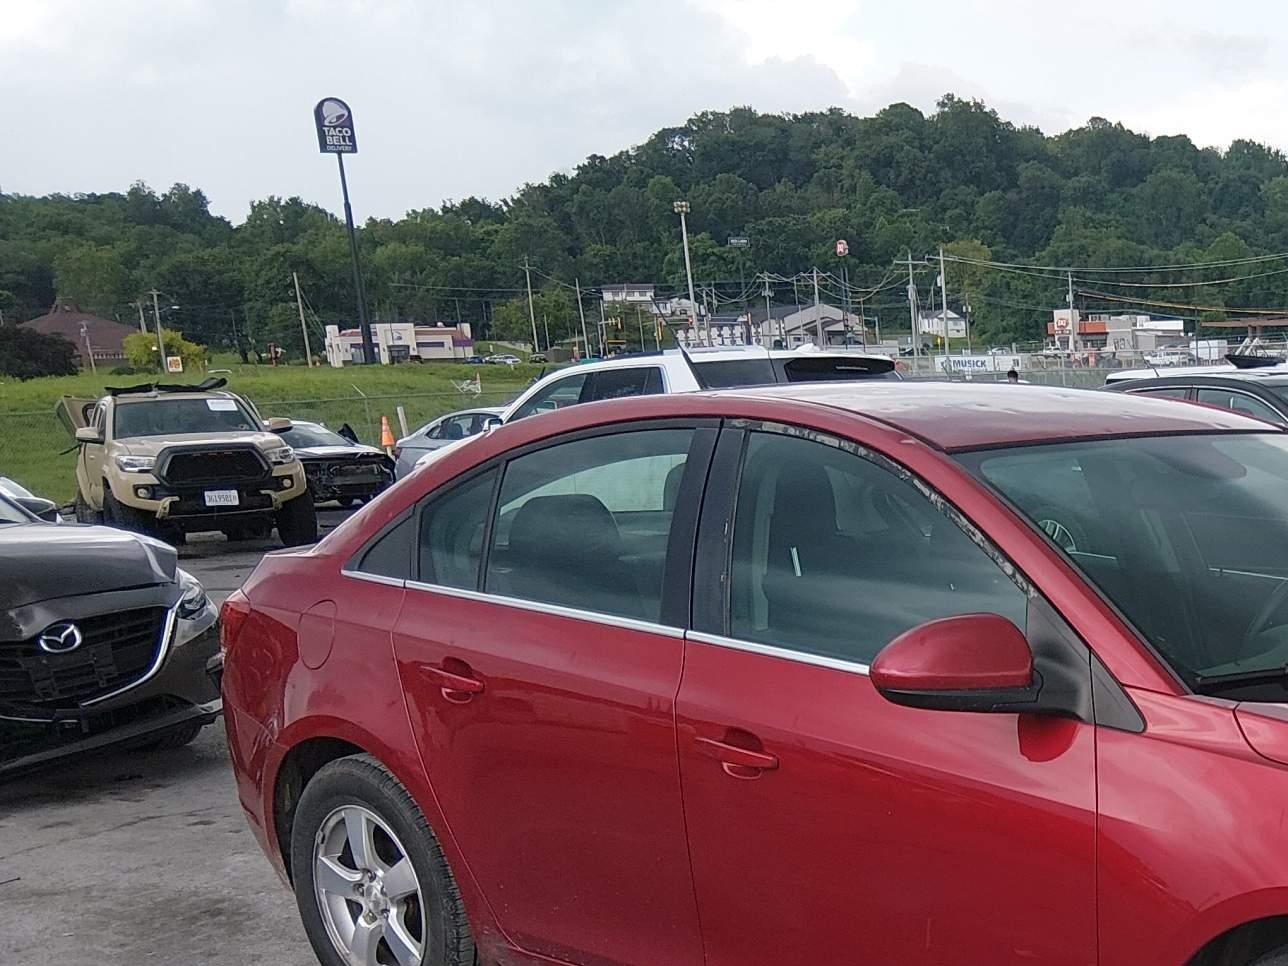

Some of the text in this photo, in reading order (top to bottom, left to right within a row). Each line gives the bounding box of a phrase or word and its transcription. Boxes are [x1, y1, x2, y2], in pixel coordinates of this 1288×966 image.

[322, 127, 352, 137] TACO
[326, 136, 353, 145] BELL
[952, 359, 987, 368] MUSICK
